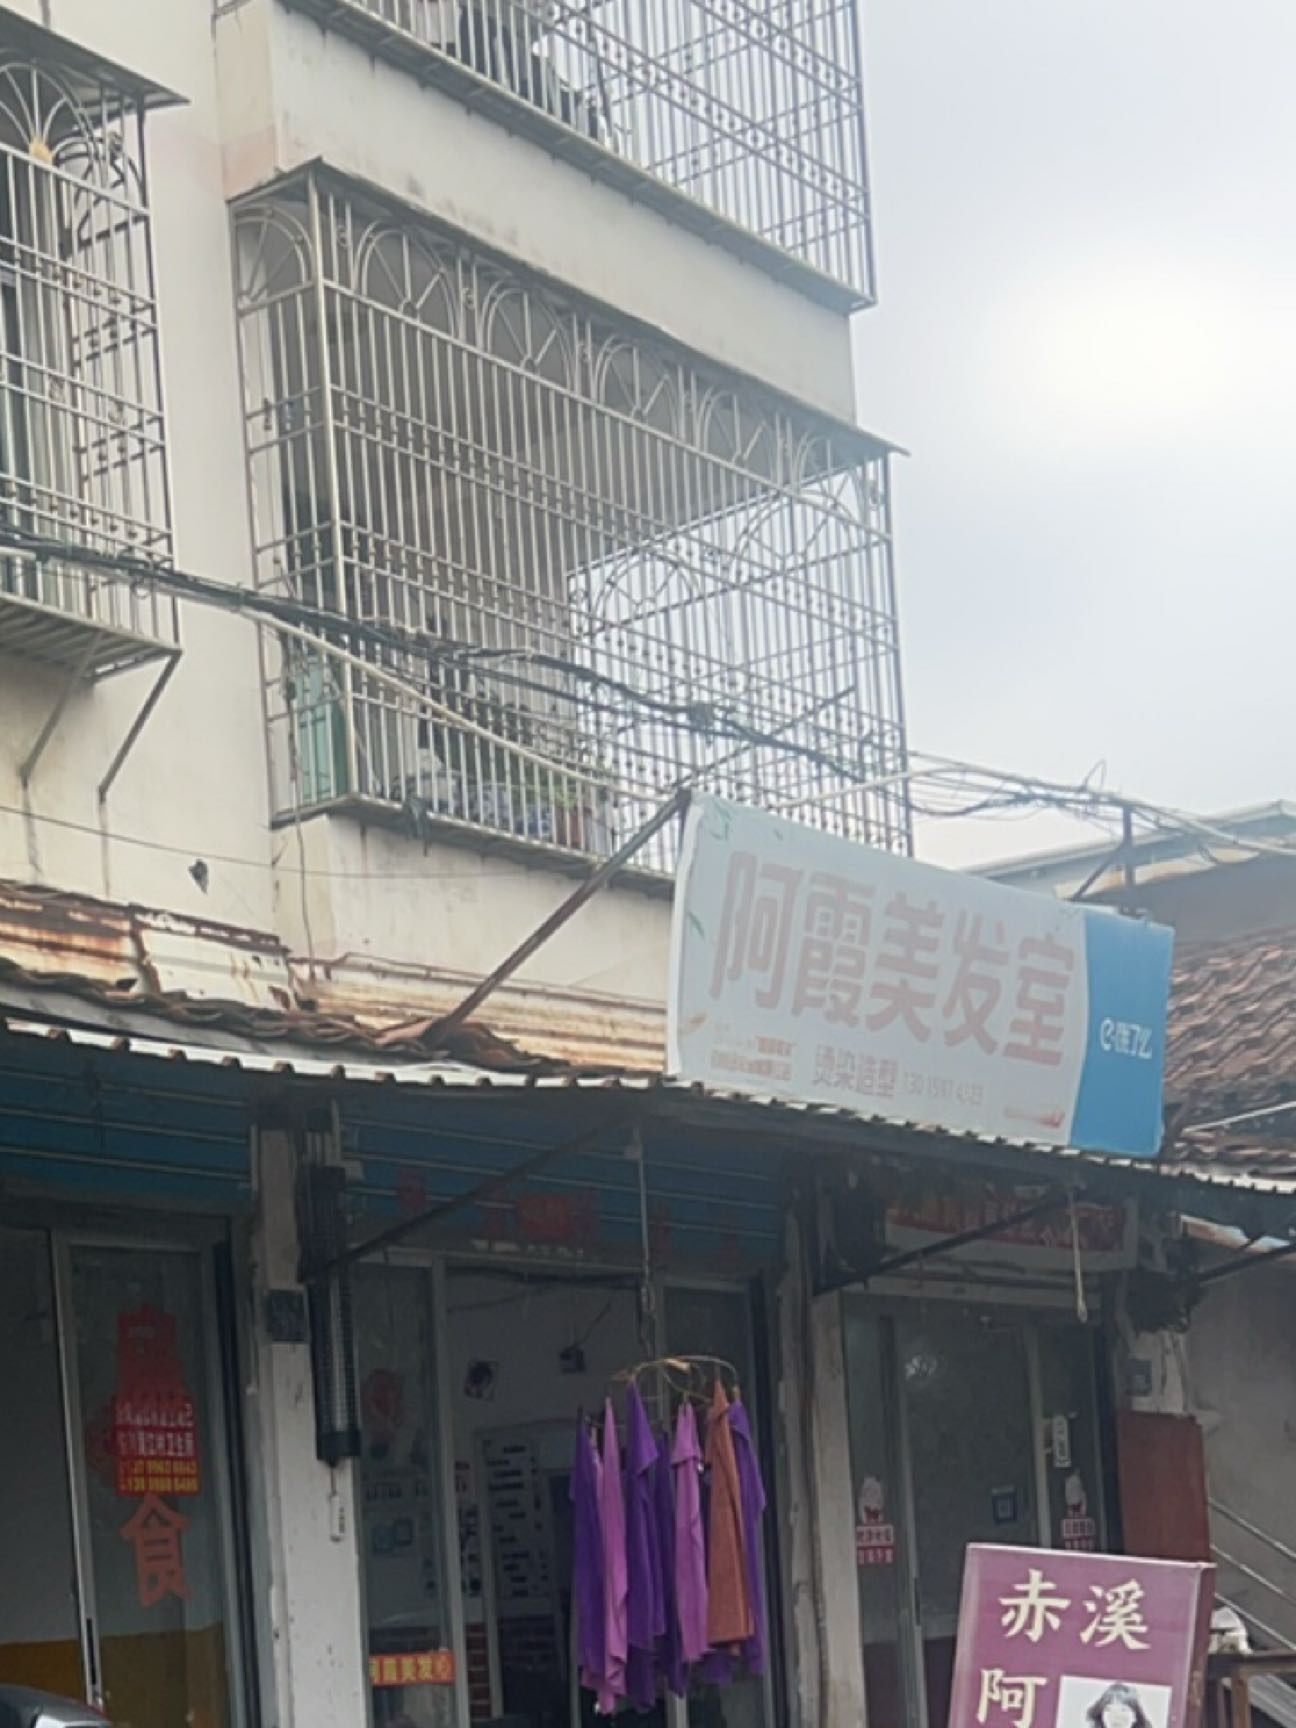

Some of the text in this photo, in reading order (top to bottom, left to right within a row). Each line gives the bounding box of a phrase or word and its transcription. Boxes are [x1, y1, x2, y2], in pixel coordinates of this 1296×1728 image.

[708, 848, 1078, 1069] 阿霞美发室
[999, 1568, 1152, 1651] 赤溪
